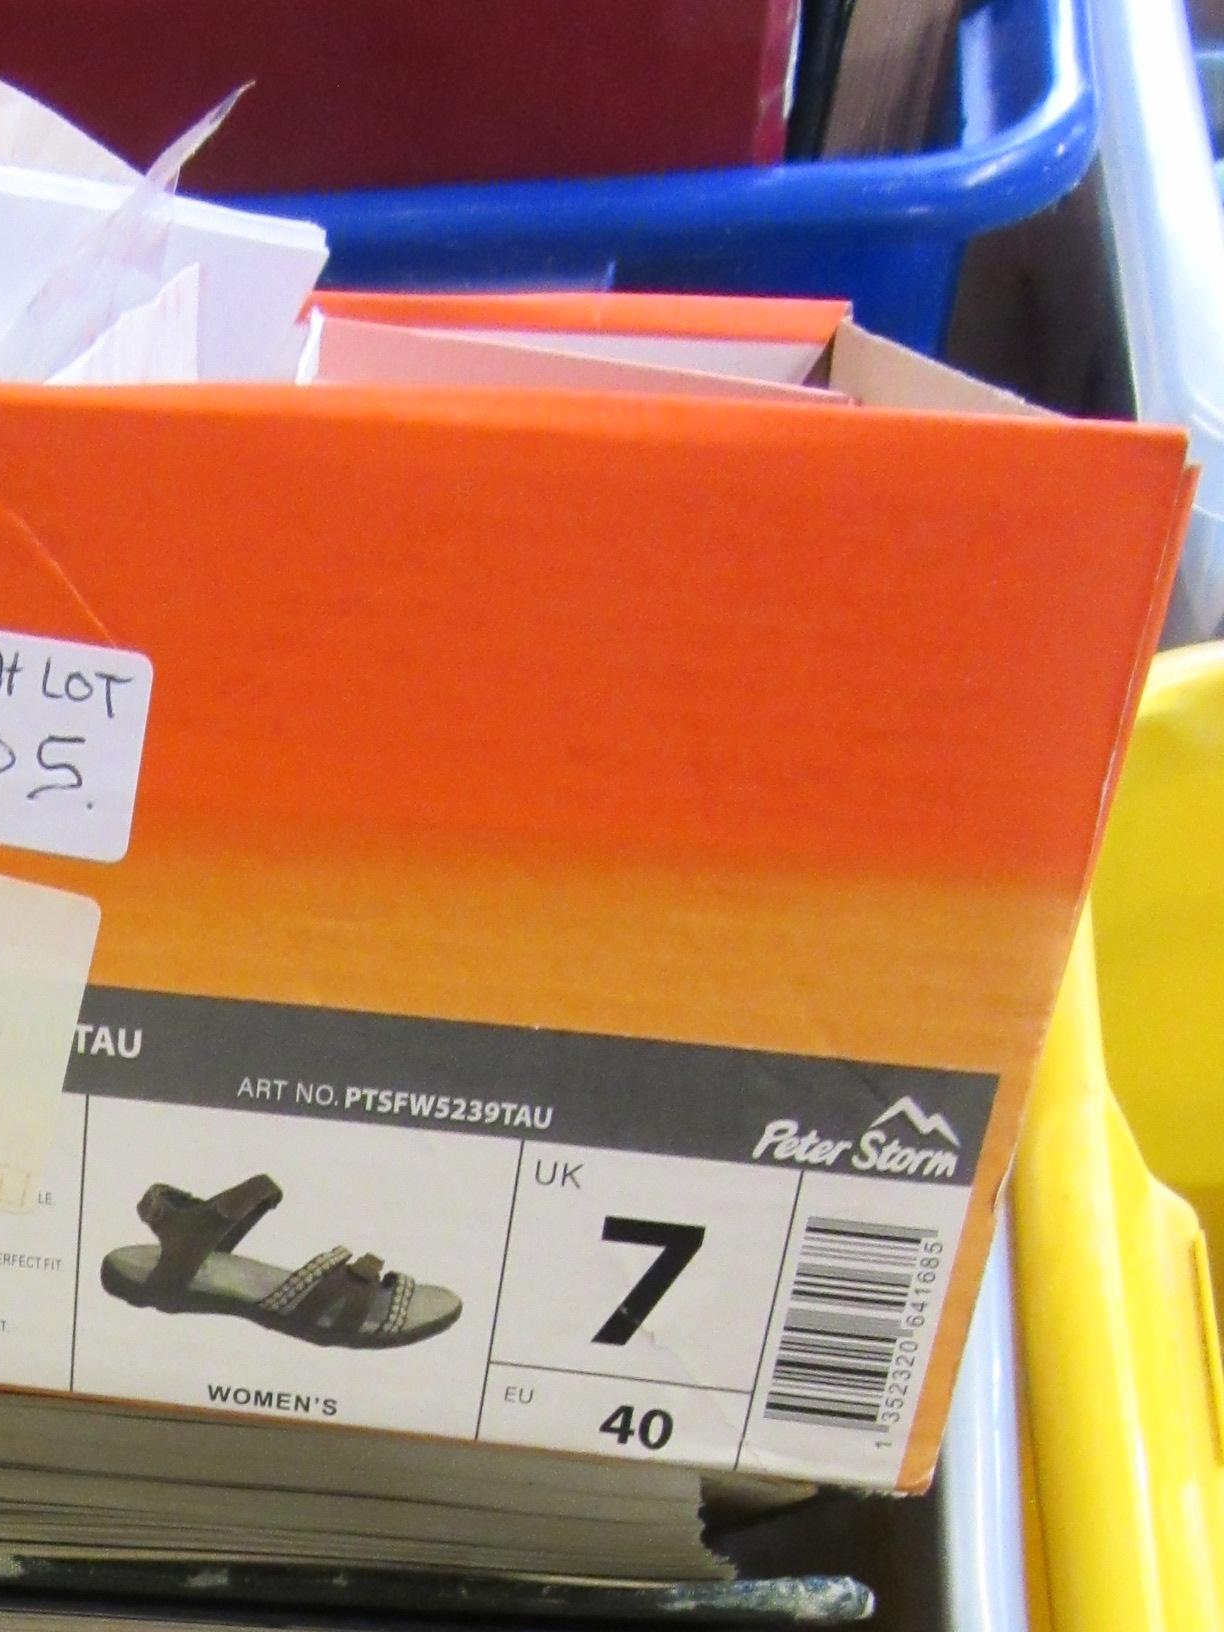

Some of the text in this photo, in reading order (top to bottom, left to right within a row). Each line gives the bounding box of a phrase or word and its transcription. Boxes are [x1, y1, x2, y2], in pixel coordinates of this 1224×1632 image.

[42, 656, 133, 718] LOT
[76, 1023, 143, 1059] TAU
[237, 1076, 554, 1130] ART NO. PTSFW5239TAU
[751, 1118, 960, 1178] Peter Storm
[534, 1158, 584, 1189] UK
[590, 1215, 706, 1346] 7
[881, 1339, 920, 1424] 352320
[905, 1240, 944, 1329] 641685
[207, 1383, 338, 1417] WOMEN'S
[503, 1385, 534, 1404] EU
[599, 1404, 674, 1450] 40
